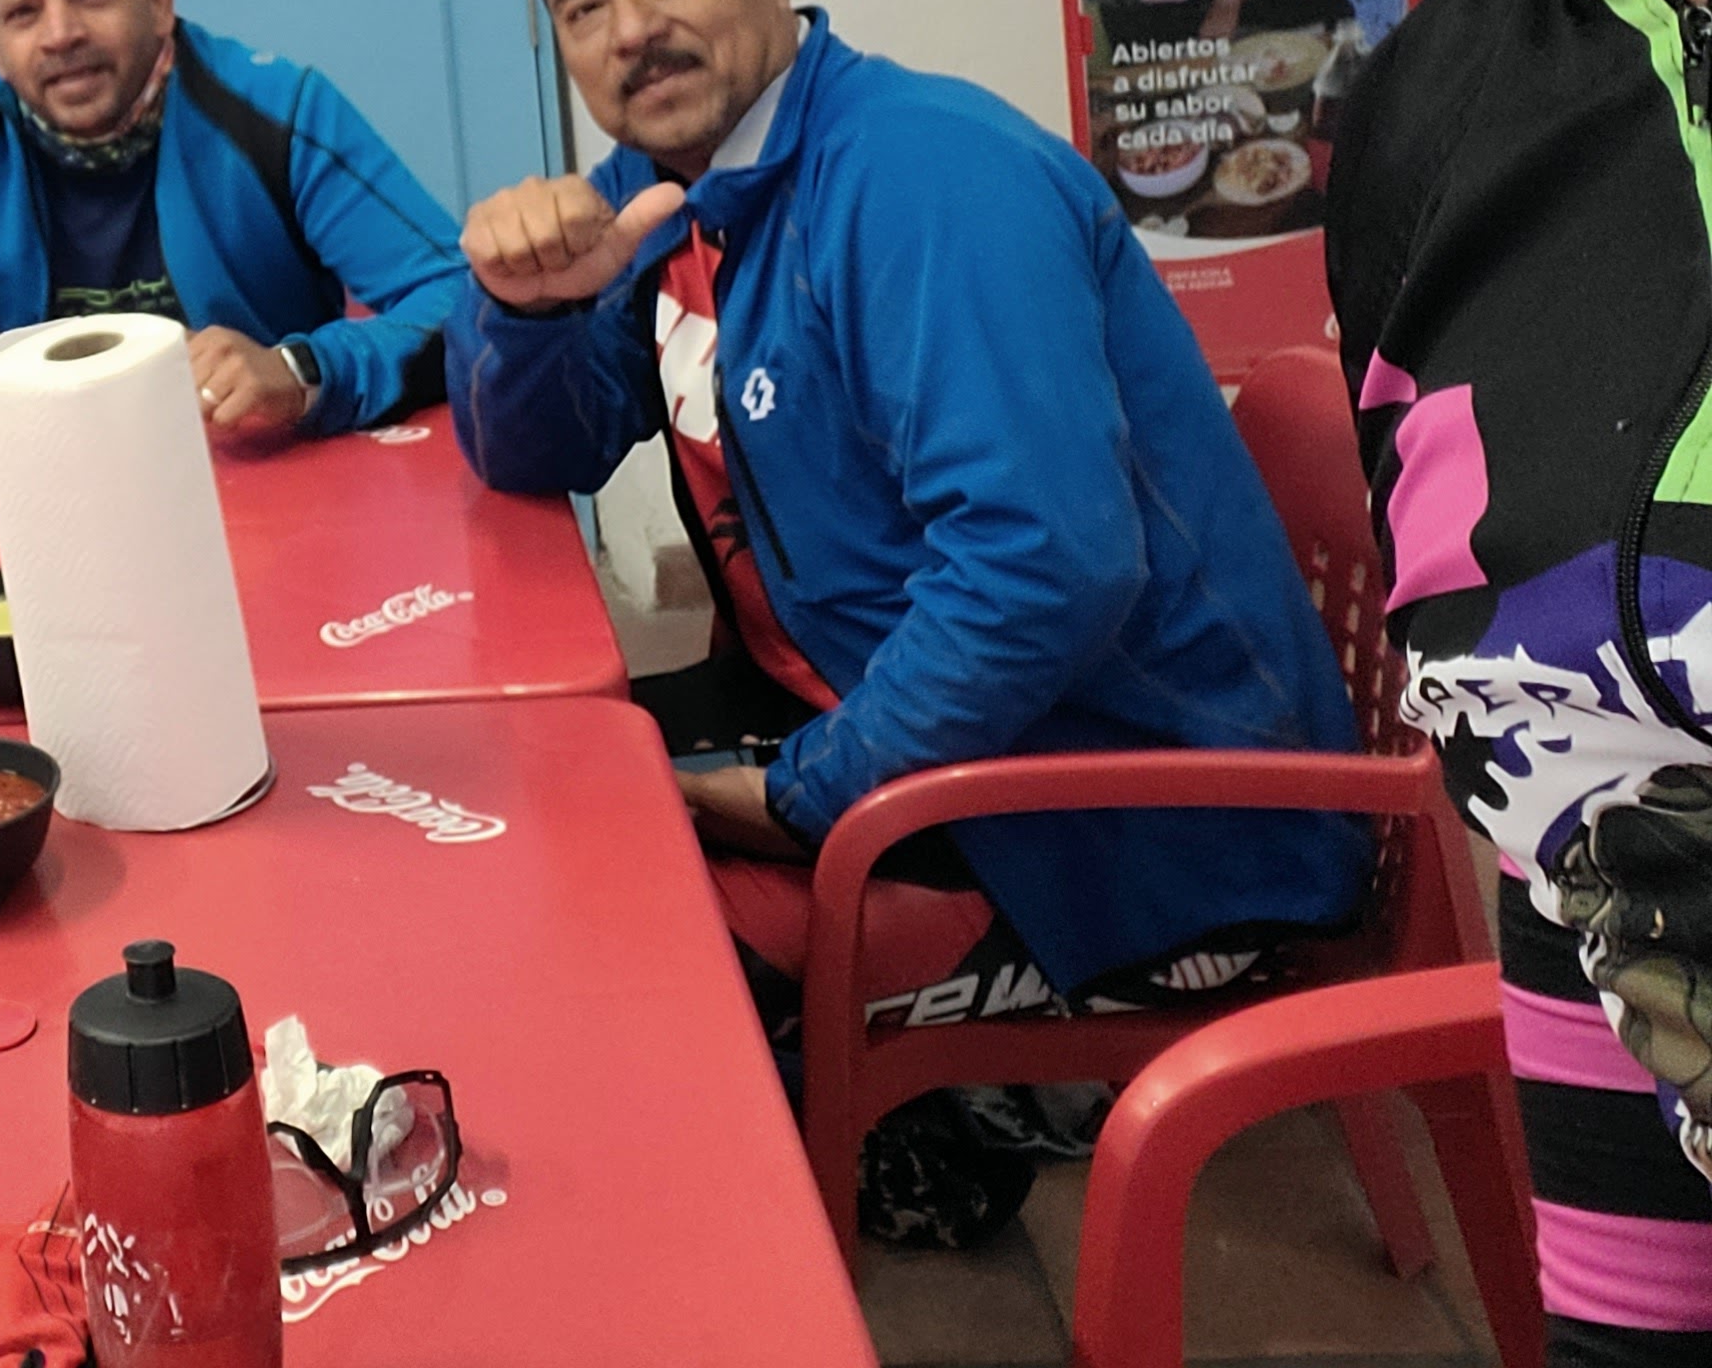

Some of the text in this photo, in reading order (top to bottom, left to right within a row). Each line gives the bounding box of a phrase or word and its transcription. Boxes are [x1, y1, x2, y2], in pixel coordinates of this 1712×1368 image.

[1112, 38, 1230, 66] Abiertos
[1113, 62, 1258, 93] a disfrutar
[1115, 93, 1234, 122] su sabor
[1117, 125, 1184, 151] cada
